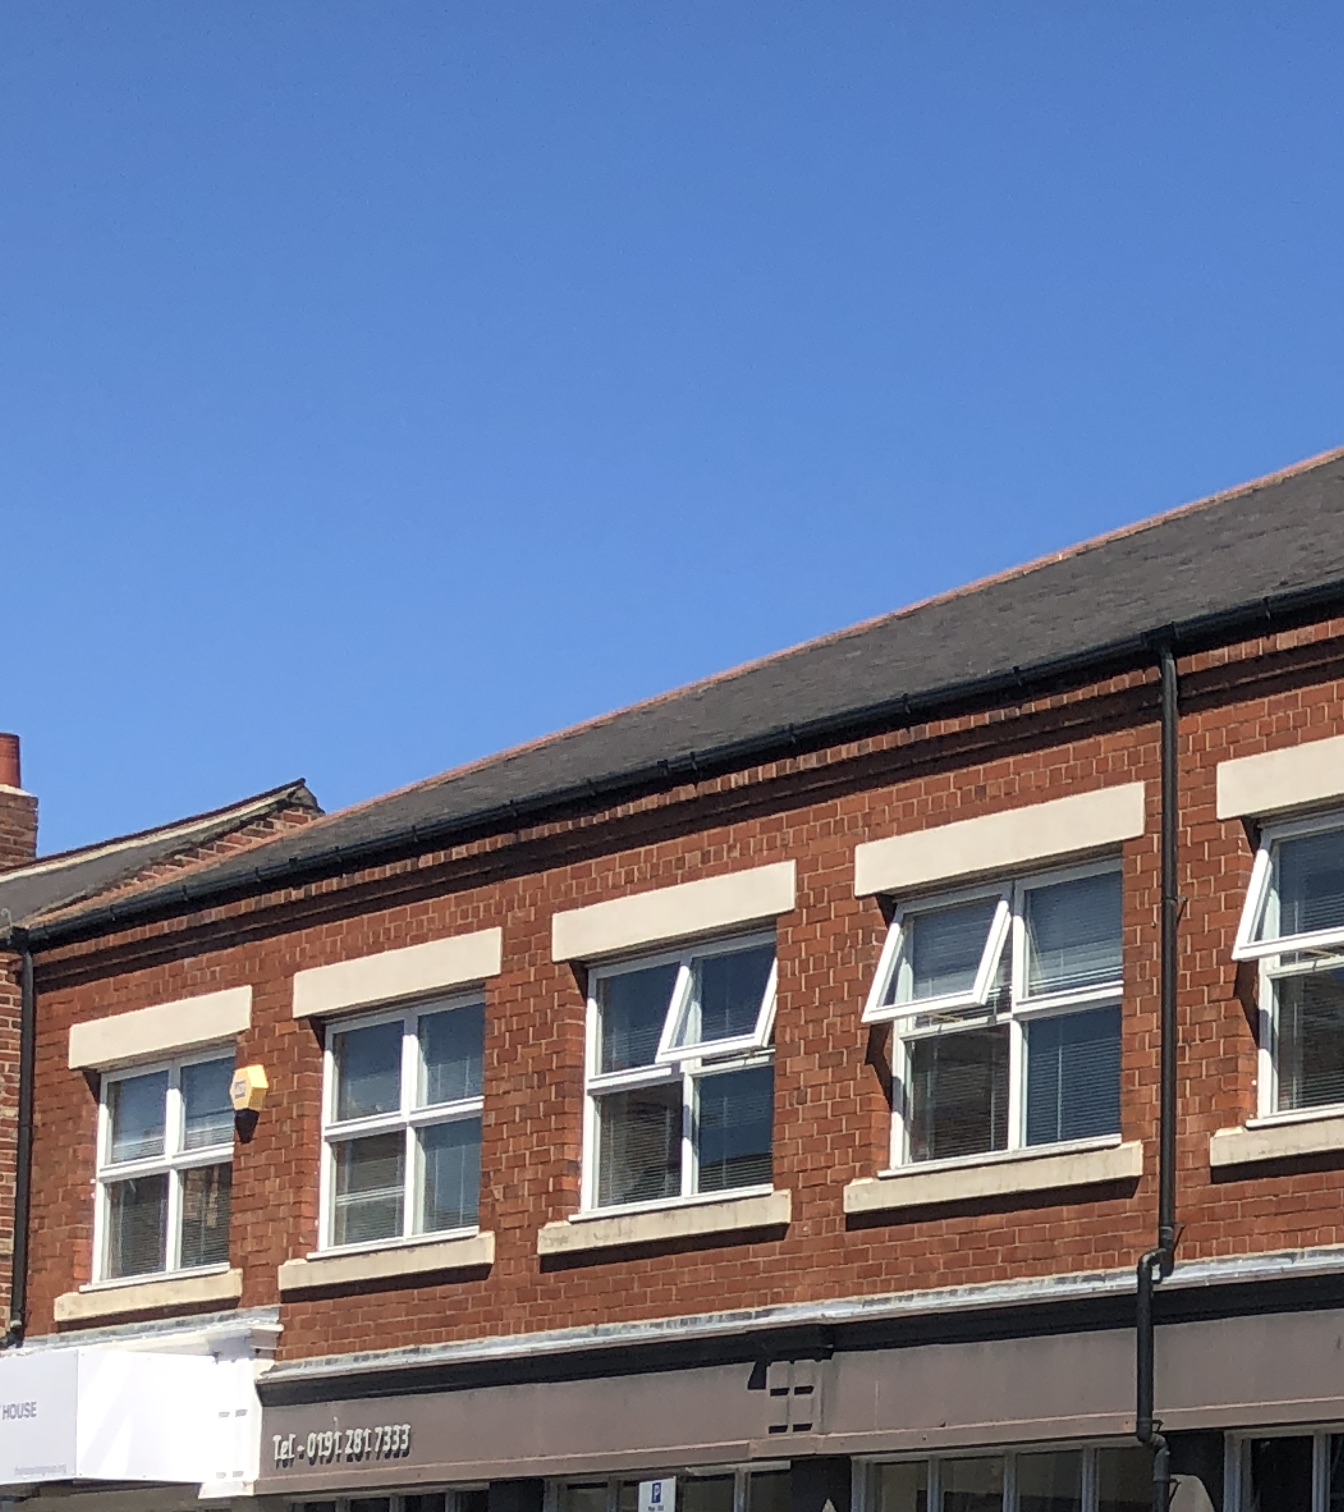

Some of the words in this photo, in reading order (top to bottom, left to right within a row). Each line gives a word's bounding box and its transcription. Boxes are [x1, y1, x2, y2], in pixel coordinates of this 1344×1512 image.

[2, 1401, 38, 1420] HOUSE
[273, 1433, 297, 1460] Tel
[306, 1431, 342, 1458] 0191
[345, 1428, 372, 1454] 281
[374, 1424, 411, 1453] 7333
